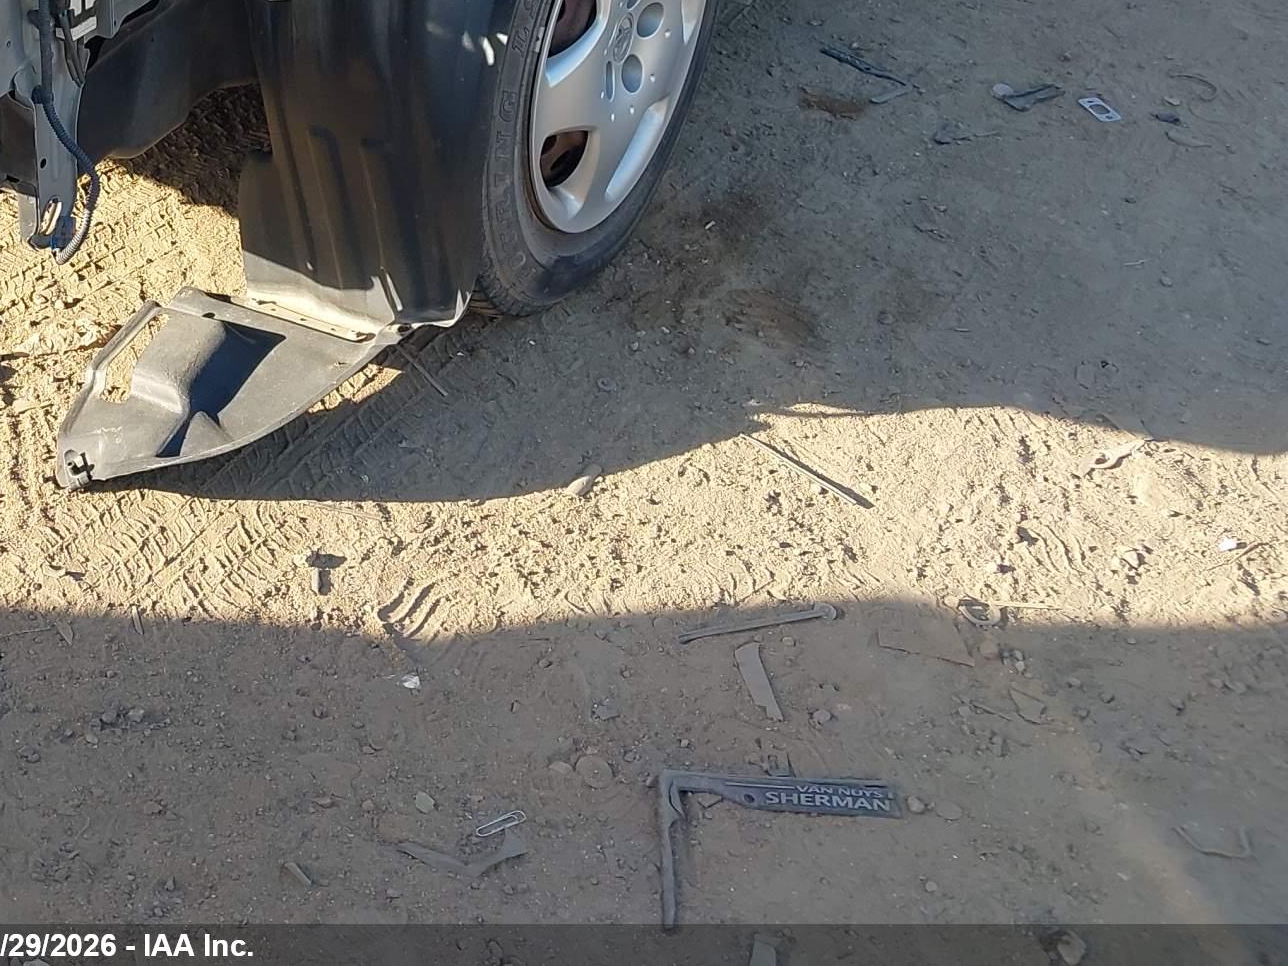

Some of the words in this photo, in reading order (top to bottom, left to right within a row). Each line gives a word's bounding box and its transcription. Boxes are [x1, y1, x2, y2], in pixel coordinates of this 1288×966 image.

[796, 785, 833, 794] VAN
[838, 788, 883, 798] NUYS
[765, 791, 892, 811] SHERMAN
